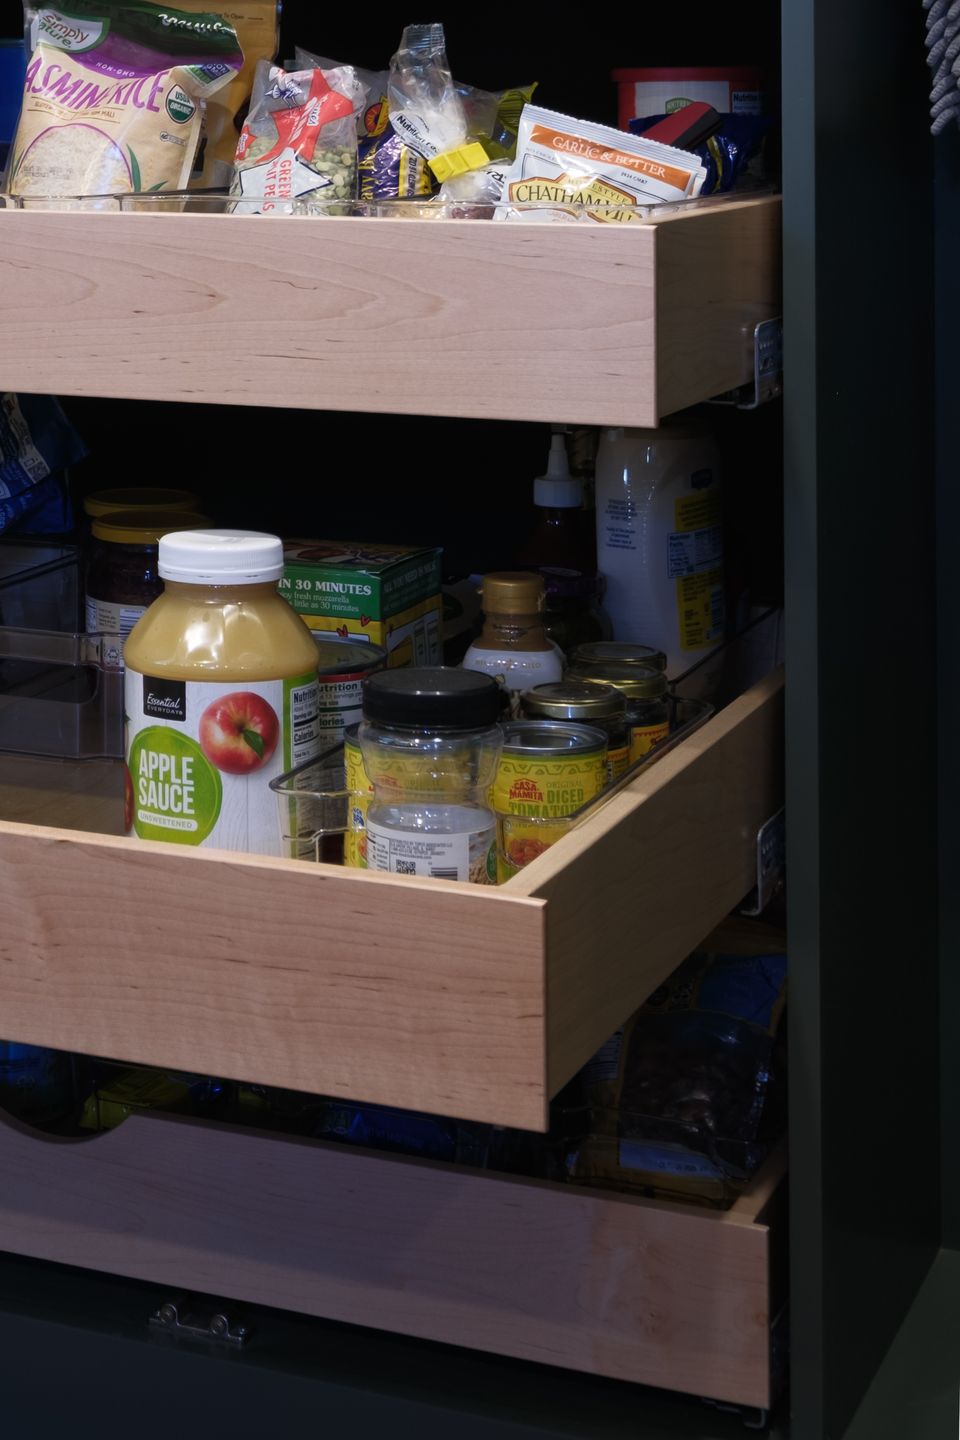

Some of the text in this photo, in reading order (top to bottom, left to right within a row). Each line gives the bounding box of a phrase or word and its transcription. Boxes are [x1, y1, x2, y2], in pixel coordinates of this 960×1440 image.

[23, 56, 109, 110] ASMIN
[552, 136, 599, 160] GARLIC
[600, 151, 614, 162] &
[615, 154, 666, 178] BUTTER
[278, 159, 292, 199] GREEN
[361, 176, 374, 201] avy
[515, 185, 603, 206] CHATHAM
[278, 578, 372, 596] IN 30 MINUTES
[294, 591, 350, 603] fresh mozzarella
[294, 599, 309, 608] little
[320, 601, 331, 610] 30
[331, 604, 360, 612] minutes
[146, 693, 181, 709] Essential
[147, 705, 180, 715] EVERYDAY
[139, 748, 194, 785] APPLE
[512, 781, 536, 791] CASA
[138, 777, 195, 815] SAUCE
[509, 789, 544, 803] MAMITA
[547, 789, 584, 804] DICED
[140, 812, 193, 829] UNSWEETENED
